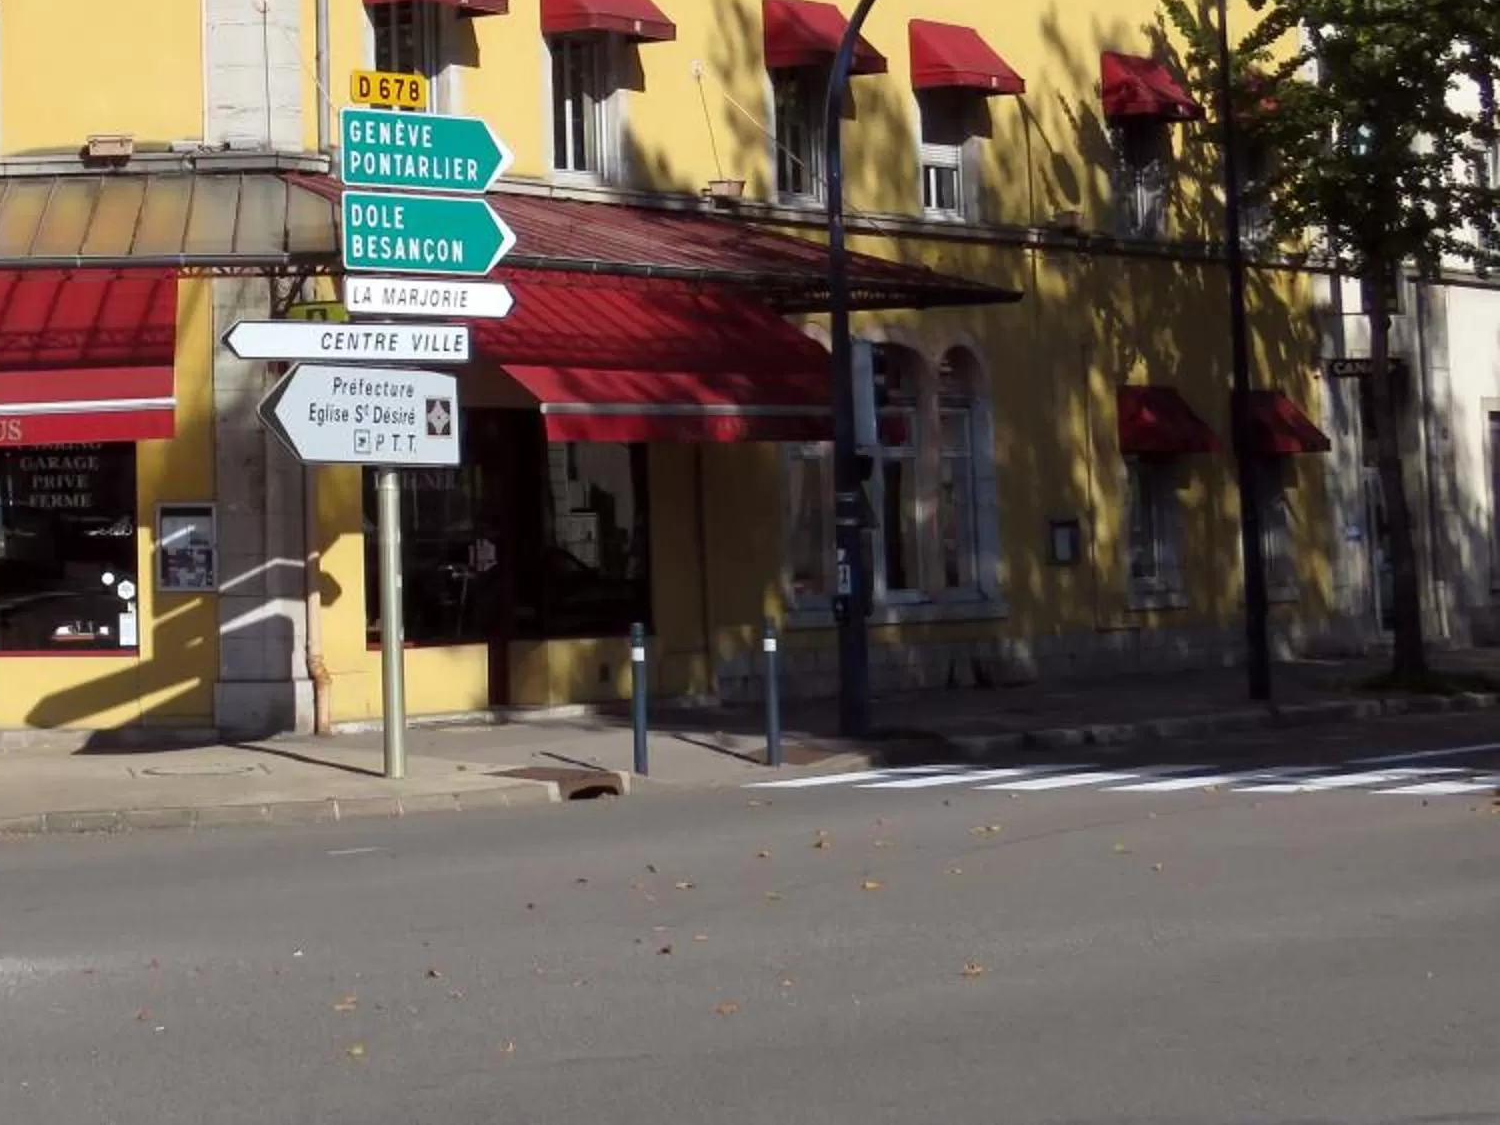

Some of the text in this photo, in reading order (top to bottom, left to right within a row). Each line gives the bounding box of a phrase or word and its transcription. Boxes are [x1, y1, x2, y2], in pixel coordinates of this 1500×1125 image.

[359, 75, 420, 102] D 678
[349, 118, 433, 148] GENÈVE
[349, 150, 478, 181] PONTARLIER
[351, 203, 405, 230] DOLE
[351, 234, 464, 264] BESANÇON
[353, 286, 469, 308] LA MARJORIE
[321, 332, 464, 353] CENTRE VILLE
[333, 376, 415, 399] Préfecture
[308, 402, 416, 426] Eglise St Désiré
[19, 455, 100, 472] GARAGE
